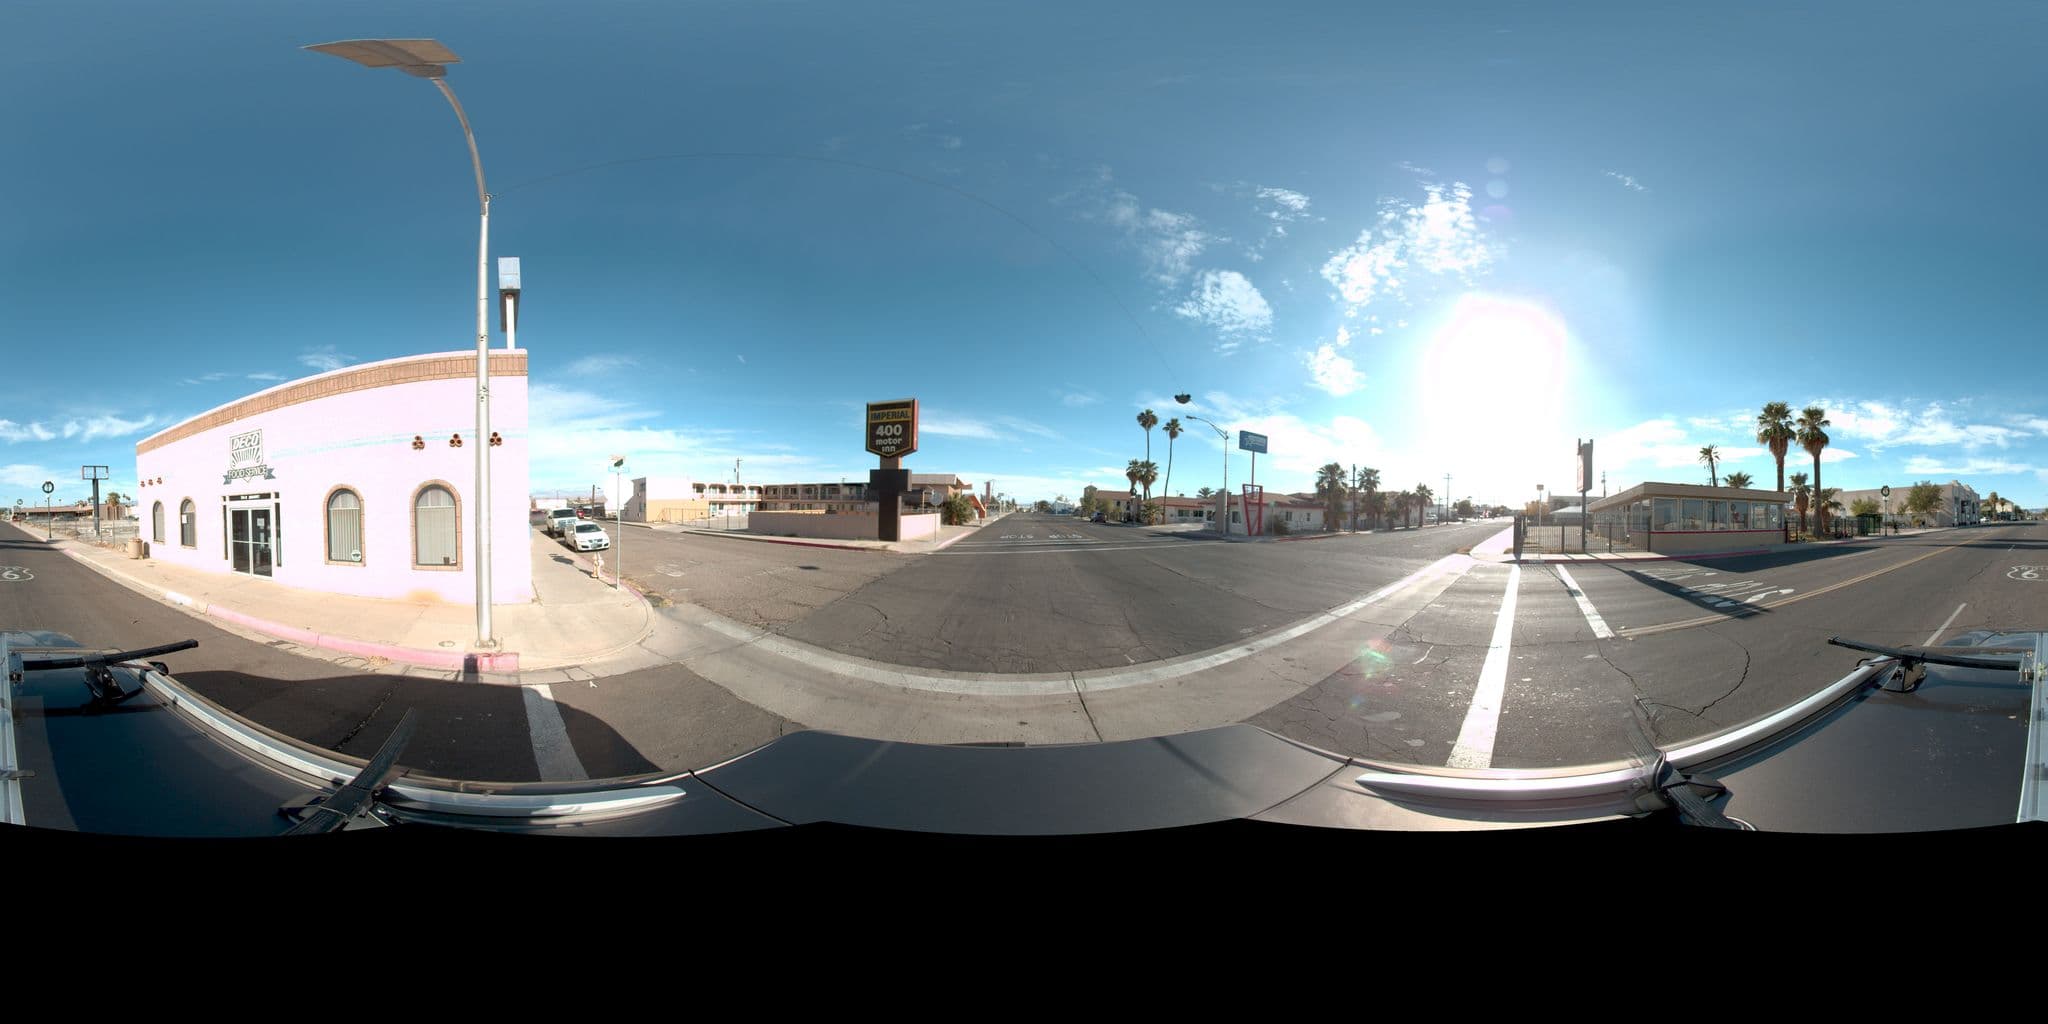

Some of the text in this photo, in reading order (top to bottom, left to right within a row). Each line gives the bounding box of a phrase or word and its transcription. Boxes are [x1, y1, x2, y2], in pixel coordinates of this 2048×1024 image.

[871, 410, 909, 421] IMPERIAL
[876, 424, 903, 436] 400
[232, 433, 259, 450] DECO
[228, 465, 267, 479] FOOD SERVICE
